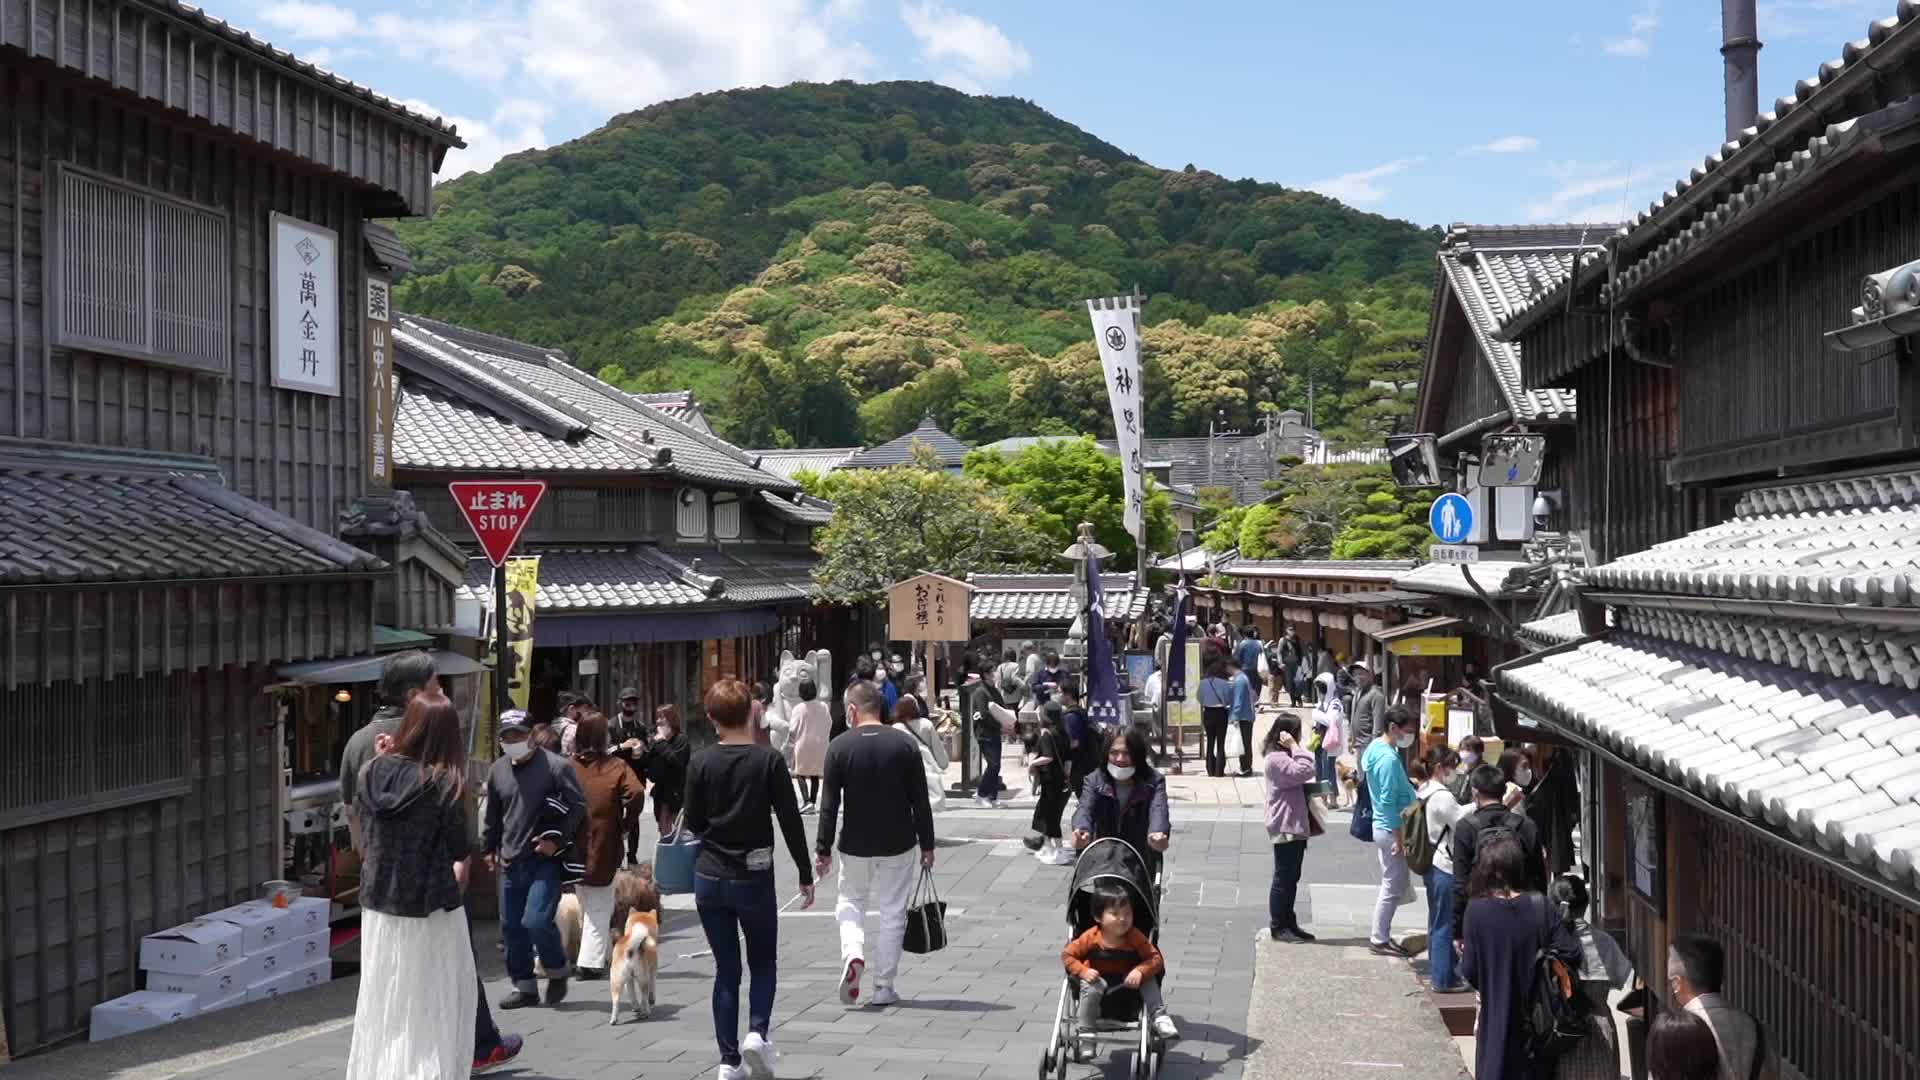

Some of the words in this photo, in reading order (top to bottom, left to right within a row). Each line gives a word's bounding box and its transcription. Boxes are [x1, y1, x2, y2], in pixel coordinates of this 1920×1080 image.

[370, 284, 386, 318] 薬
[299, 271, 320, 377] 萬金丹
[372, 327, 385, 477] 山中ハート薬局
[469, 491, 526, 510] 止まれ
[479, 515, 518, 530] STOP
[915, 584, 931, 631] おかげ横丁
[936, 582, 945, 626] これより
